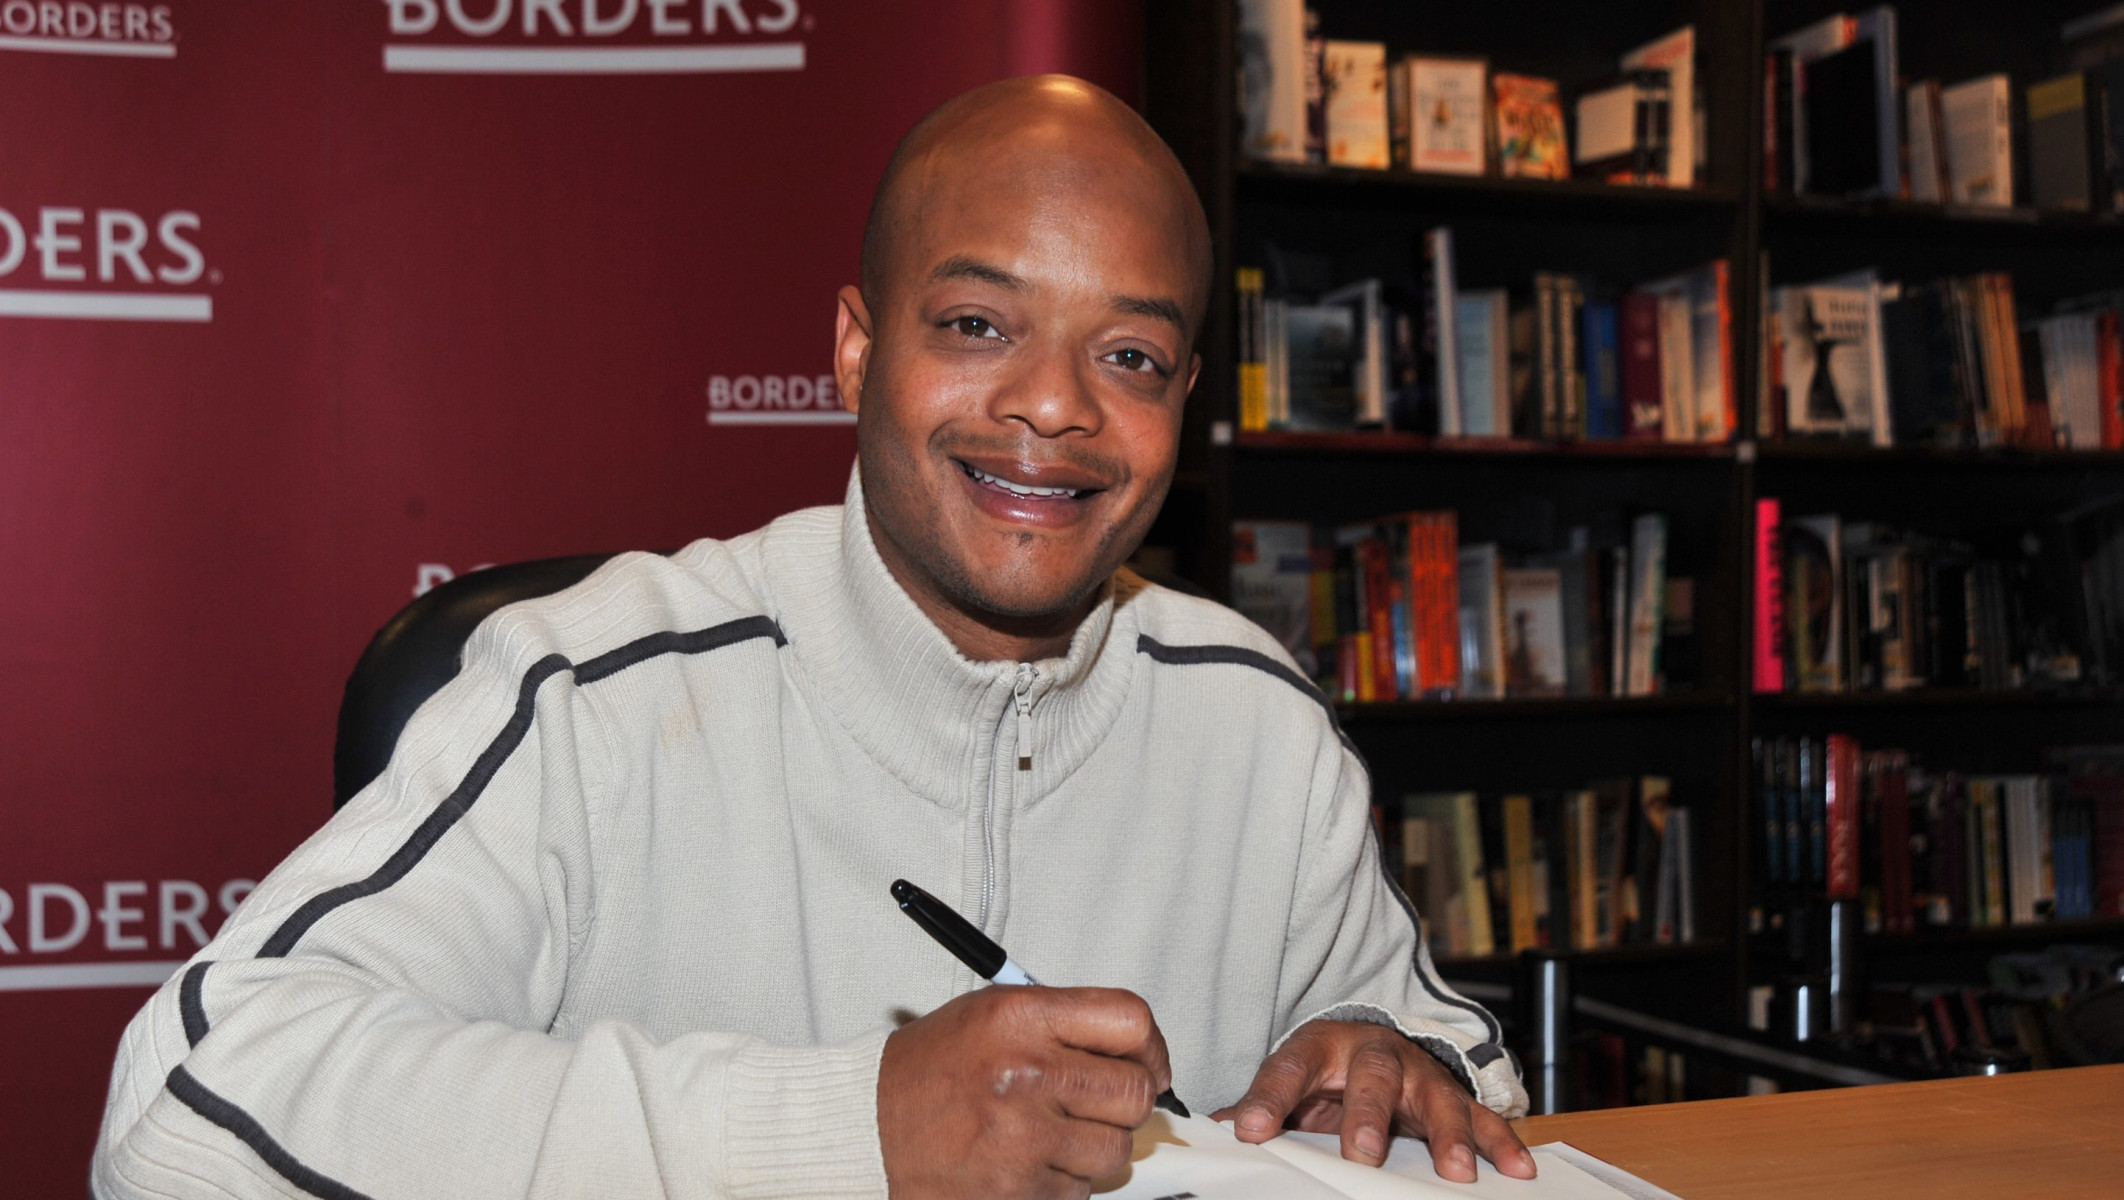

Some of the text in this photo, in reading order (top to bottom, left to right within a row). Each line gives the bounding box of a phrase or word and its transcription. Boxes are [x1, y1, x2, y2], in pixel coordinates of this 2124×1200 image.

[0, 1, 174, 42] ORDERS
[384, 0, 800, 35] BORDERS
[709, 374, 843, 409] BORDE
